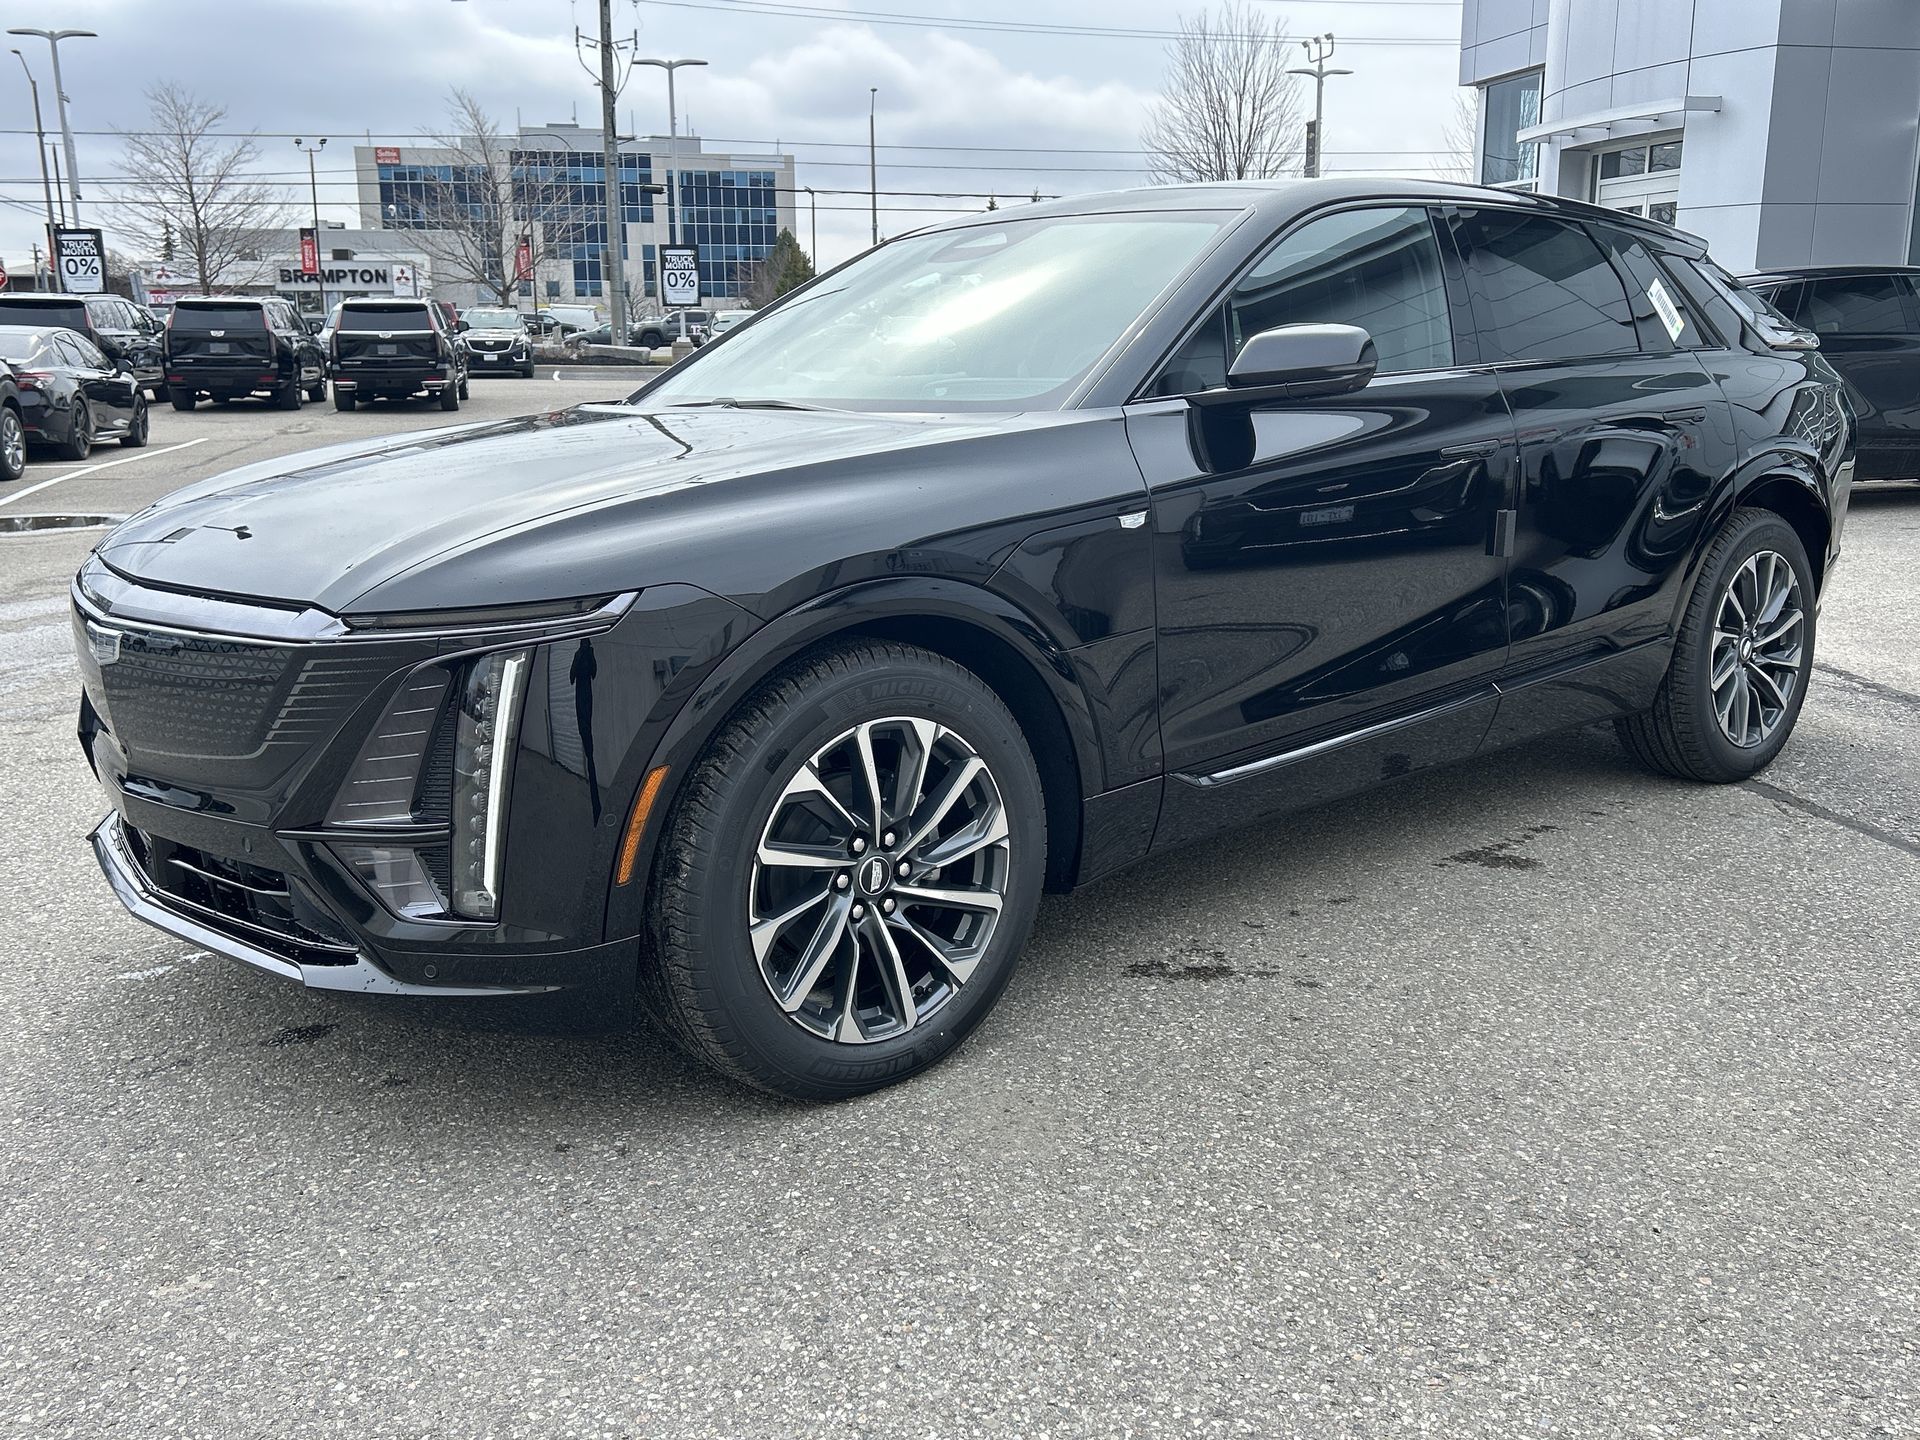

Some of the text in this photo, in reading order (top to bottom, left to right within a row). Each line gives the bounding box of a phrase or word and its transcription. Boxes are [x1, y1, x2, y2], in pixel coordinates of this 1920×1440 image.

[61, 240, 96, 249] TRUCK
[65, 258, 99, 275] 0%
[279, 268, 388, 284] BRAMPTON
[667, 272, 695, 287] 0%
[870, 680, 967, 708] MICHELIN
